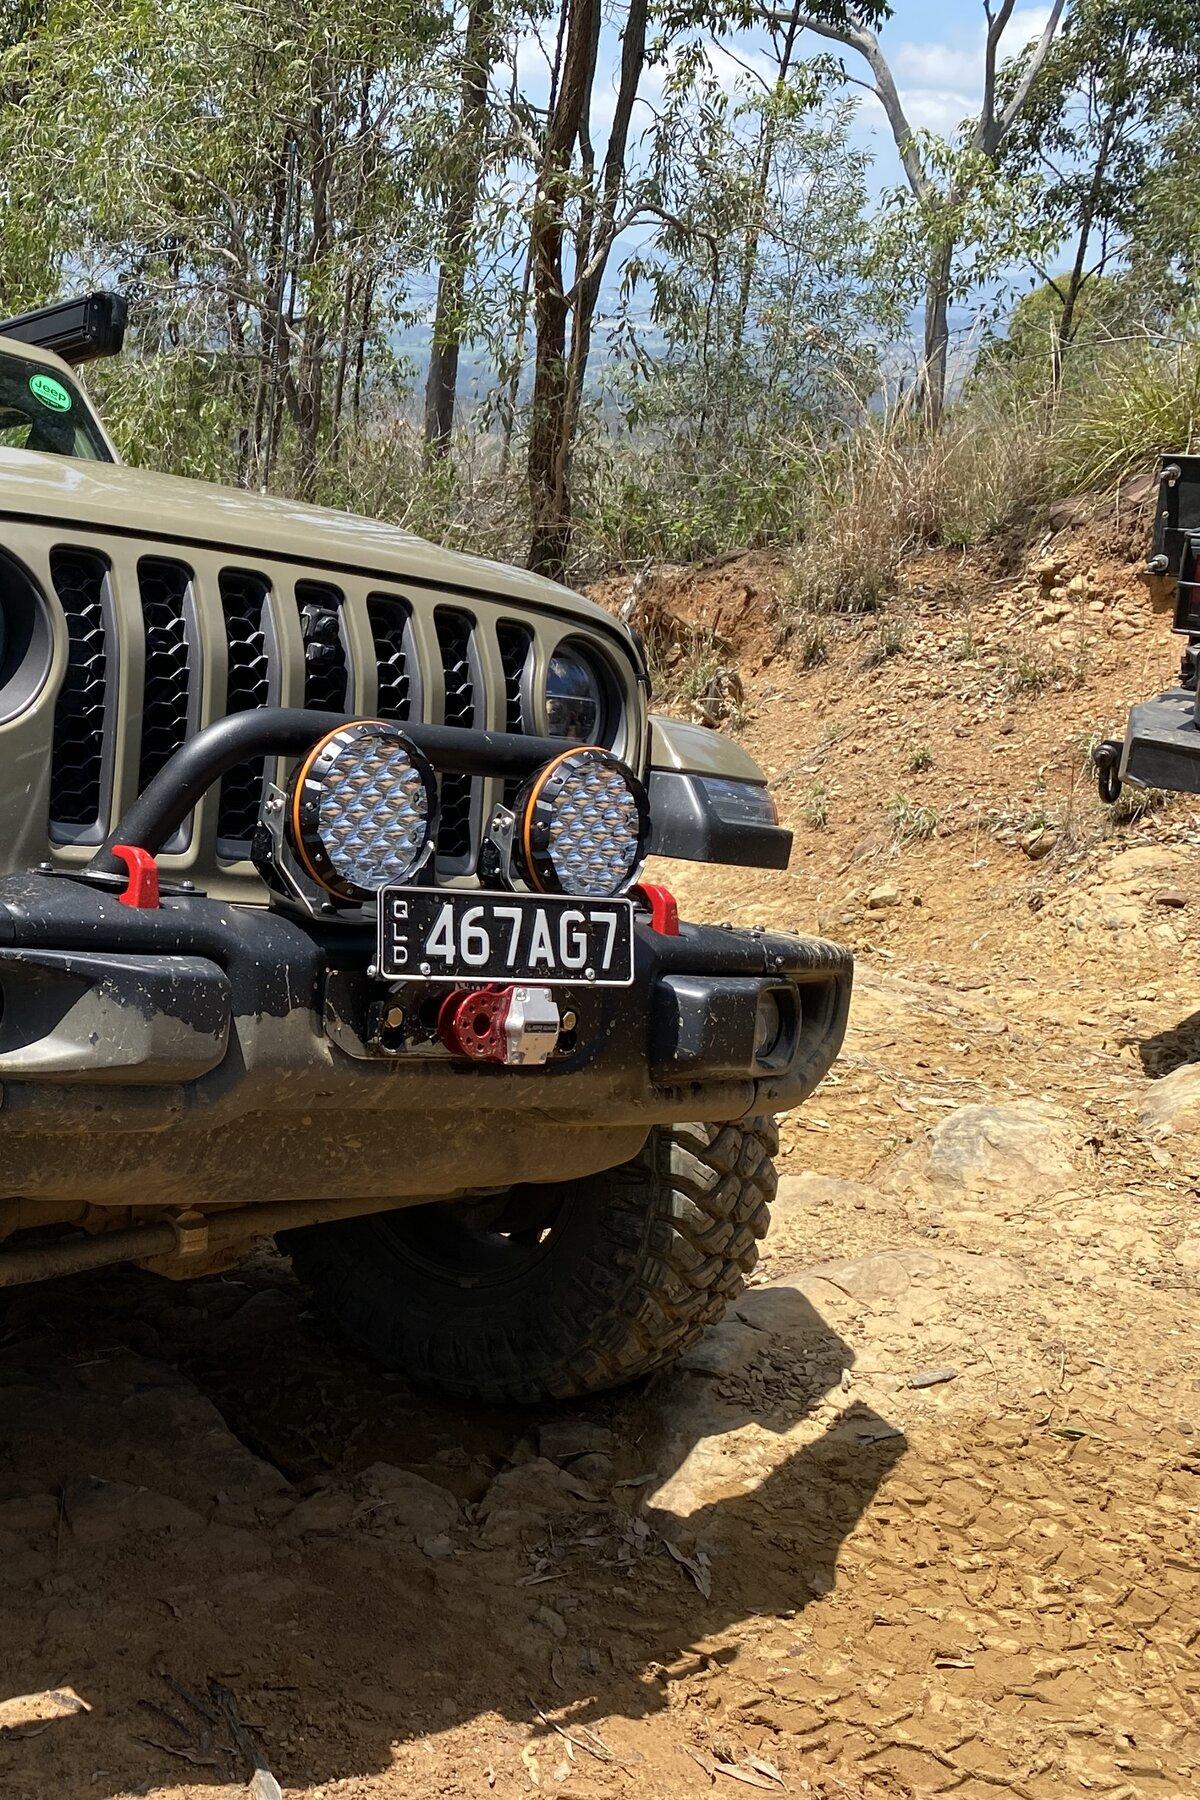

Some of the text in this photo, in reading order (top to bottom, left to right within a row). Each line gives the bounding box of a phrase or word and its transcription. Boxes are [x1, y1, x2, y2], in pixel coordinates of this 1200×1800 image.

[34, 380, 66, 401] Jeep
[393, 900, 408, 964] QLD
[425, 904, 617, 970] 467AG7
